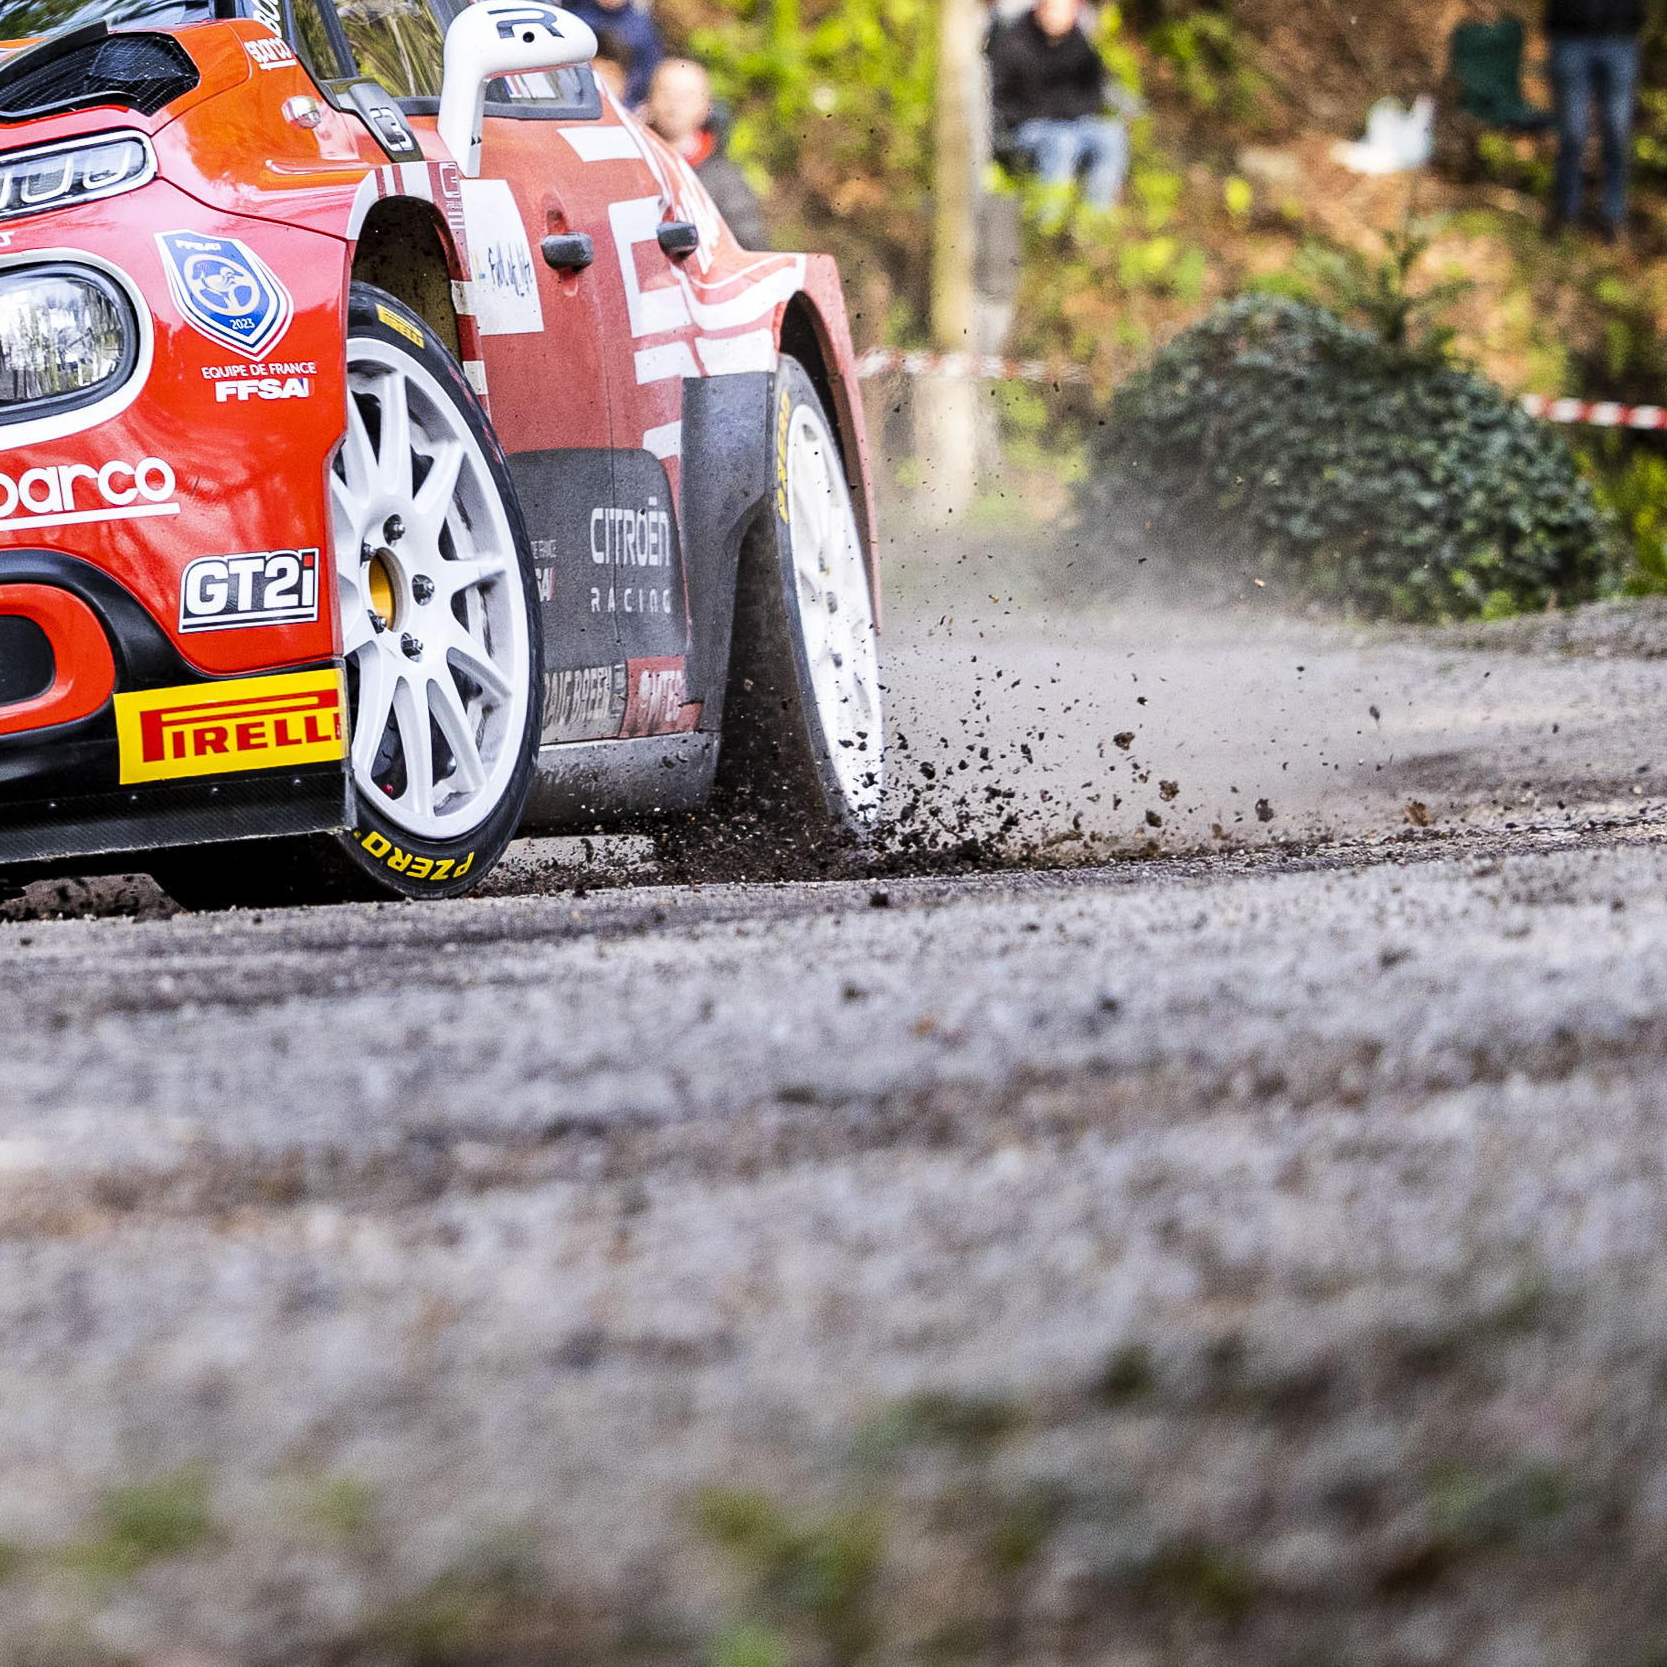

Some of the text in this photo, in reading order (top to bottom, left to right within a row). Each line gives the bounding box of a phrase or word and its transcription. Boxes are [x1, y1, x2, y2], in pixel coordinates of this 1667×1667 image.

[229, 318, 255, 330] 2023
[201, 362, 317, 379] EQUIPE DE FRANCE
[215, 378, 309, 402] FFSA
[186, 549, 317, 616] GT2i
[590, 587, 672, 614] RACING
